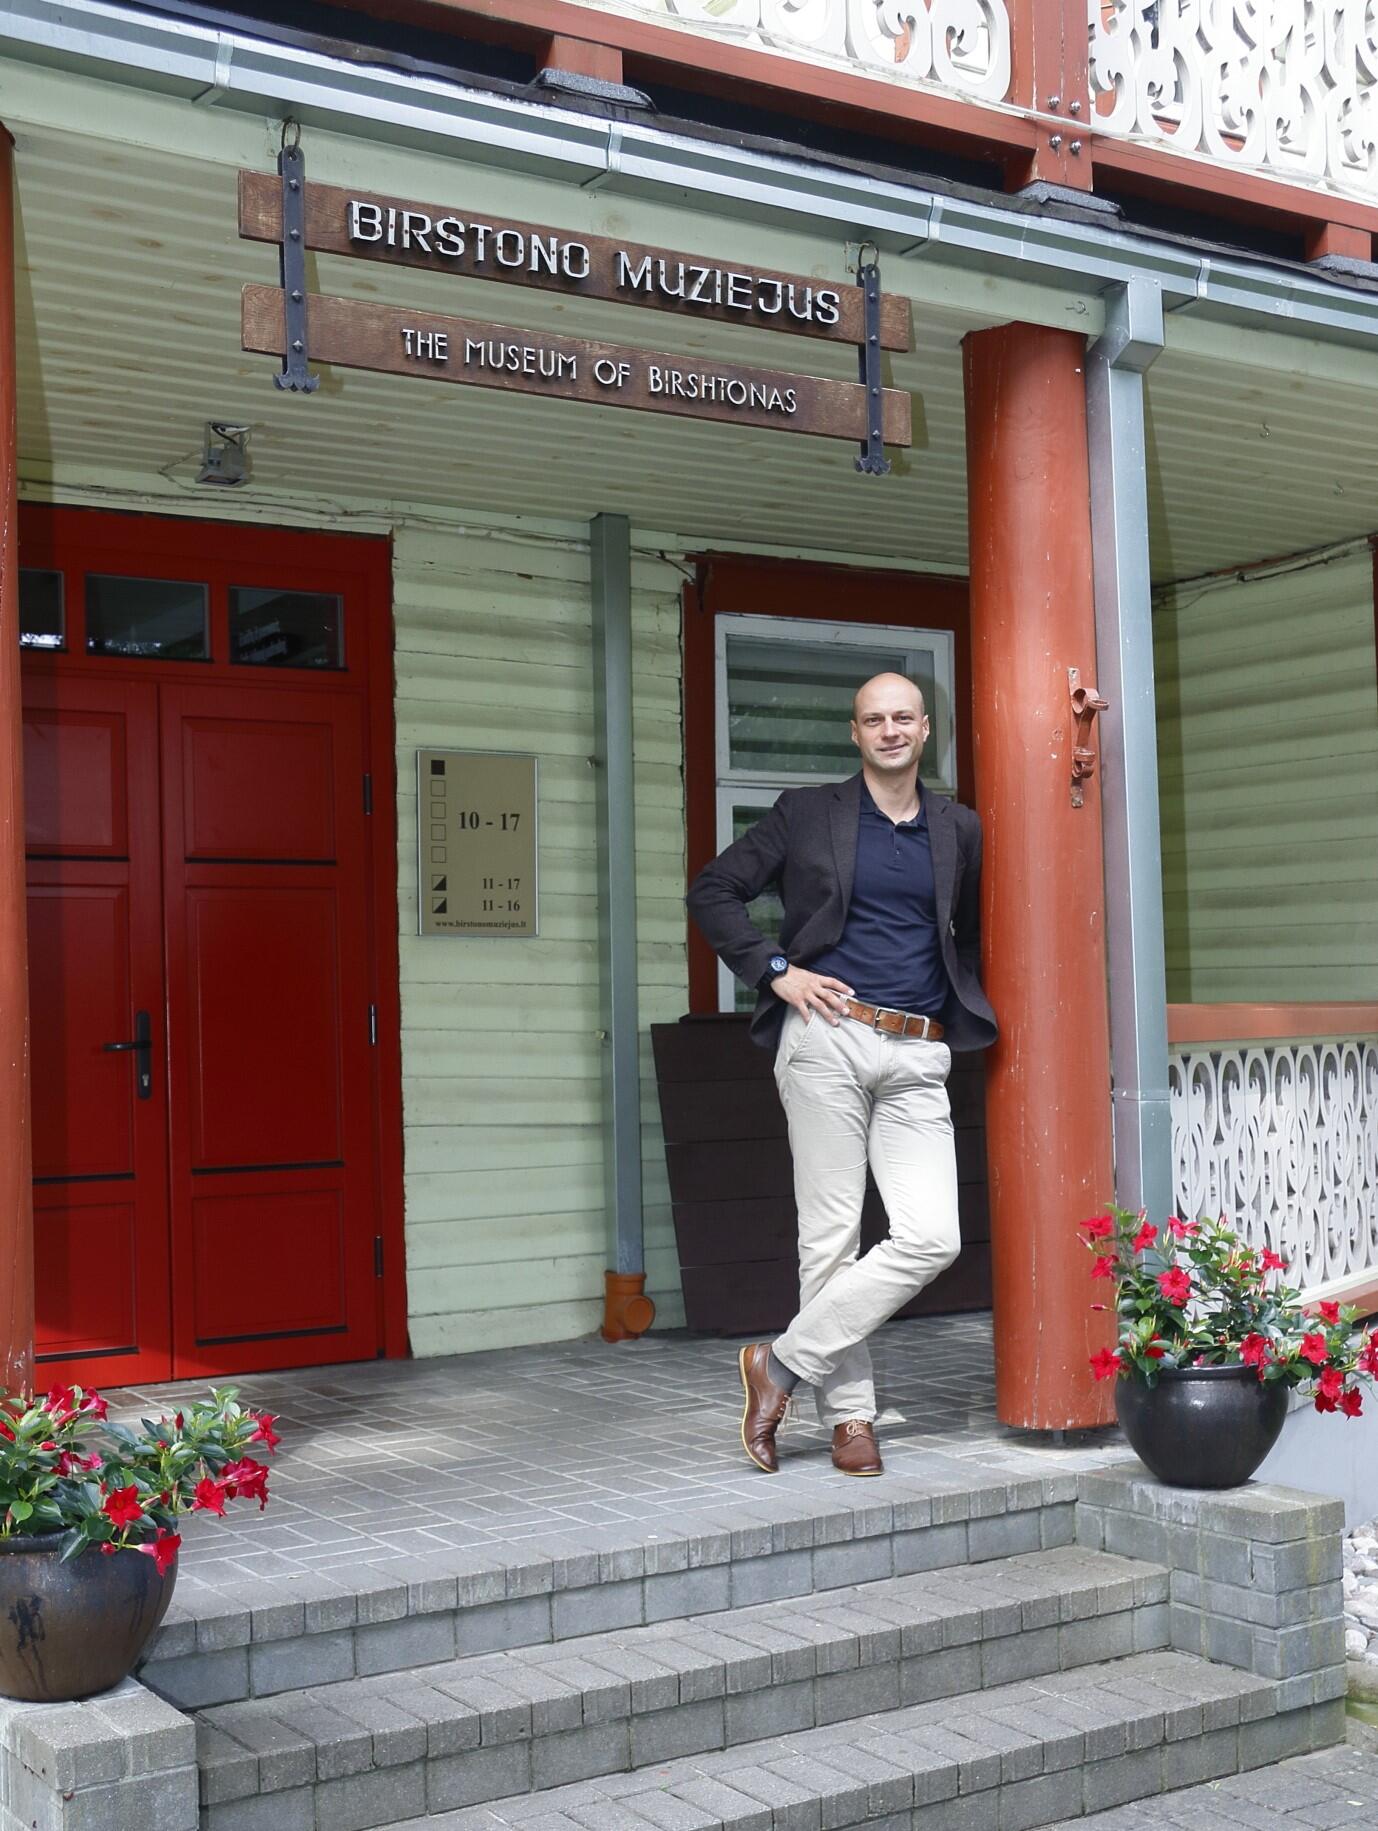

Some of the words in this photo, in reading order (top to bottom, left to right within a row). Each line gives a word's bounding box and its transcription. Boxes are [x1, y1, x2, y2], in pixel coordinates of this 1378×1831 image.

[616, 250, 841, 325] MUZIEJUS
[402, 328, 449, 361] THE
[463, 337, 578, 380] MUSEUM
[594, 358, 631, 388] OF
[649, 365, 798, 414] BIRSHTONAS
[458, 811, 480, 830] 10
[500, 813, 521, 832] 17
[482, 878, 494, 890] 11
[507, 878, 521, 890] 17
[482, 900, 494, 911] 11
[507, 900, 521, 911] 16
